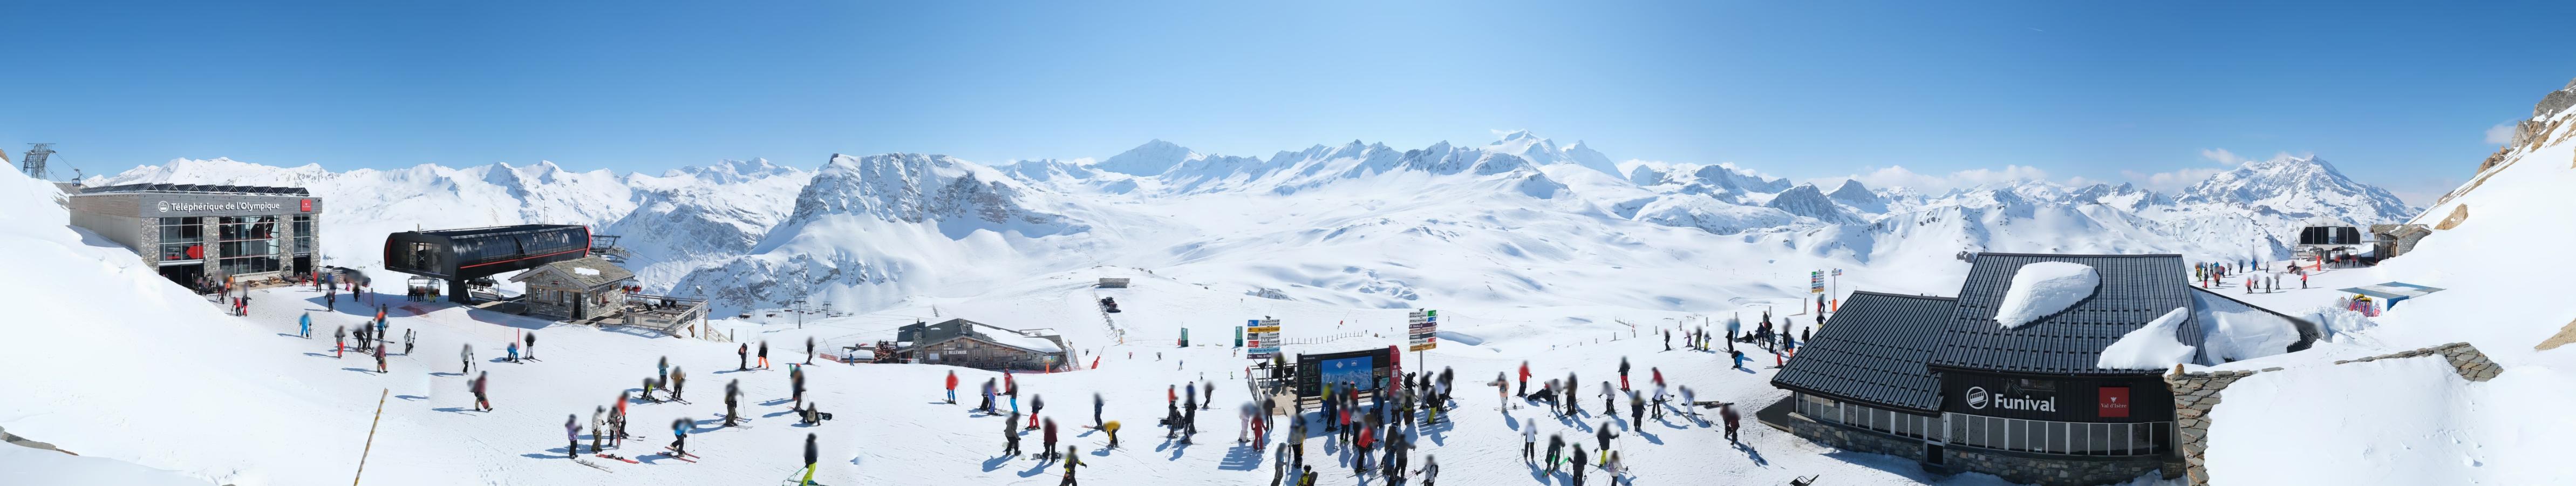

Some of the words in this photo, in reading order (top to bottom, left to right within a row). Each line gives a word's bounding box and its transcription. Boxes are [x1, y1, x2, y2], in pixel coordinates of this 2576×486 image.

[171, 202, 223, 212] Téléphérique
[236, 202, 280, 211] l'Olympique
[1995, 394, 2055, 412] Funival
